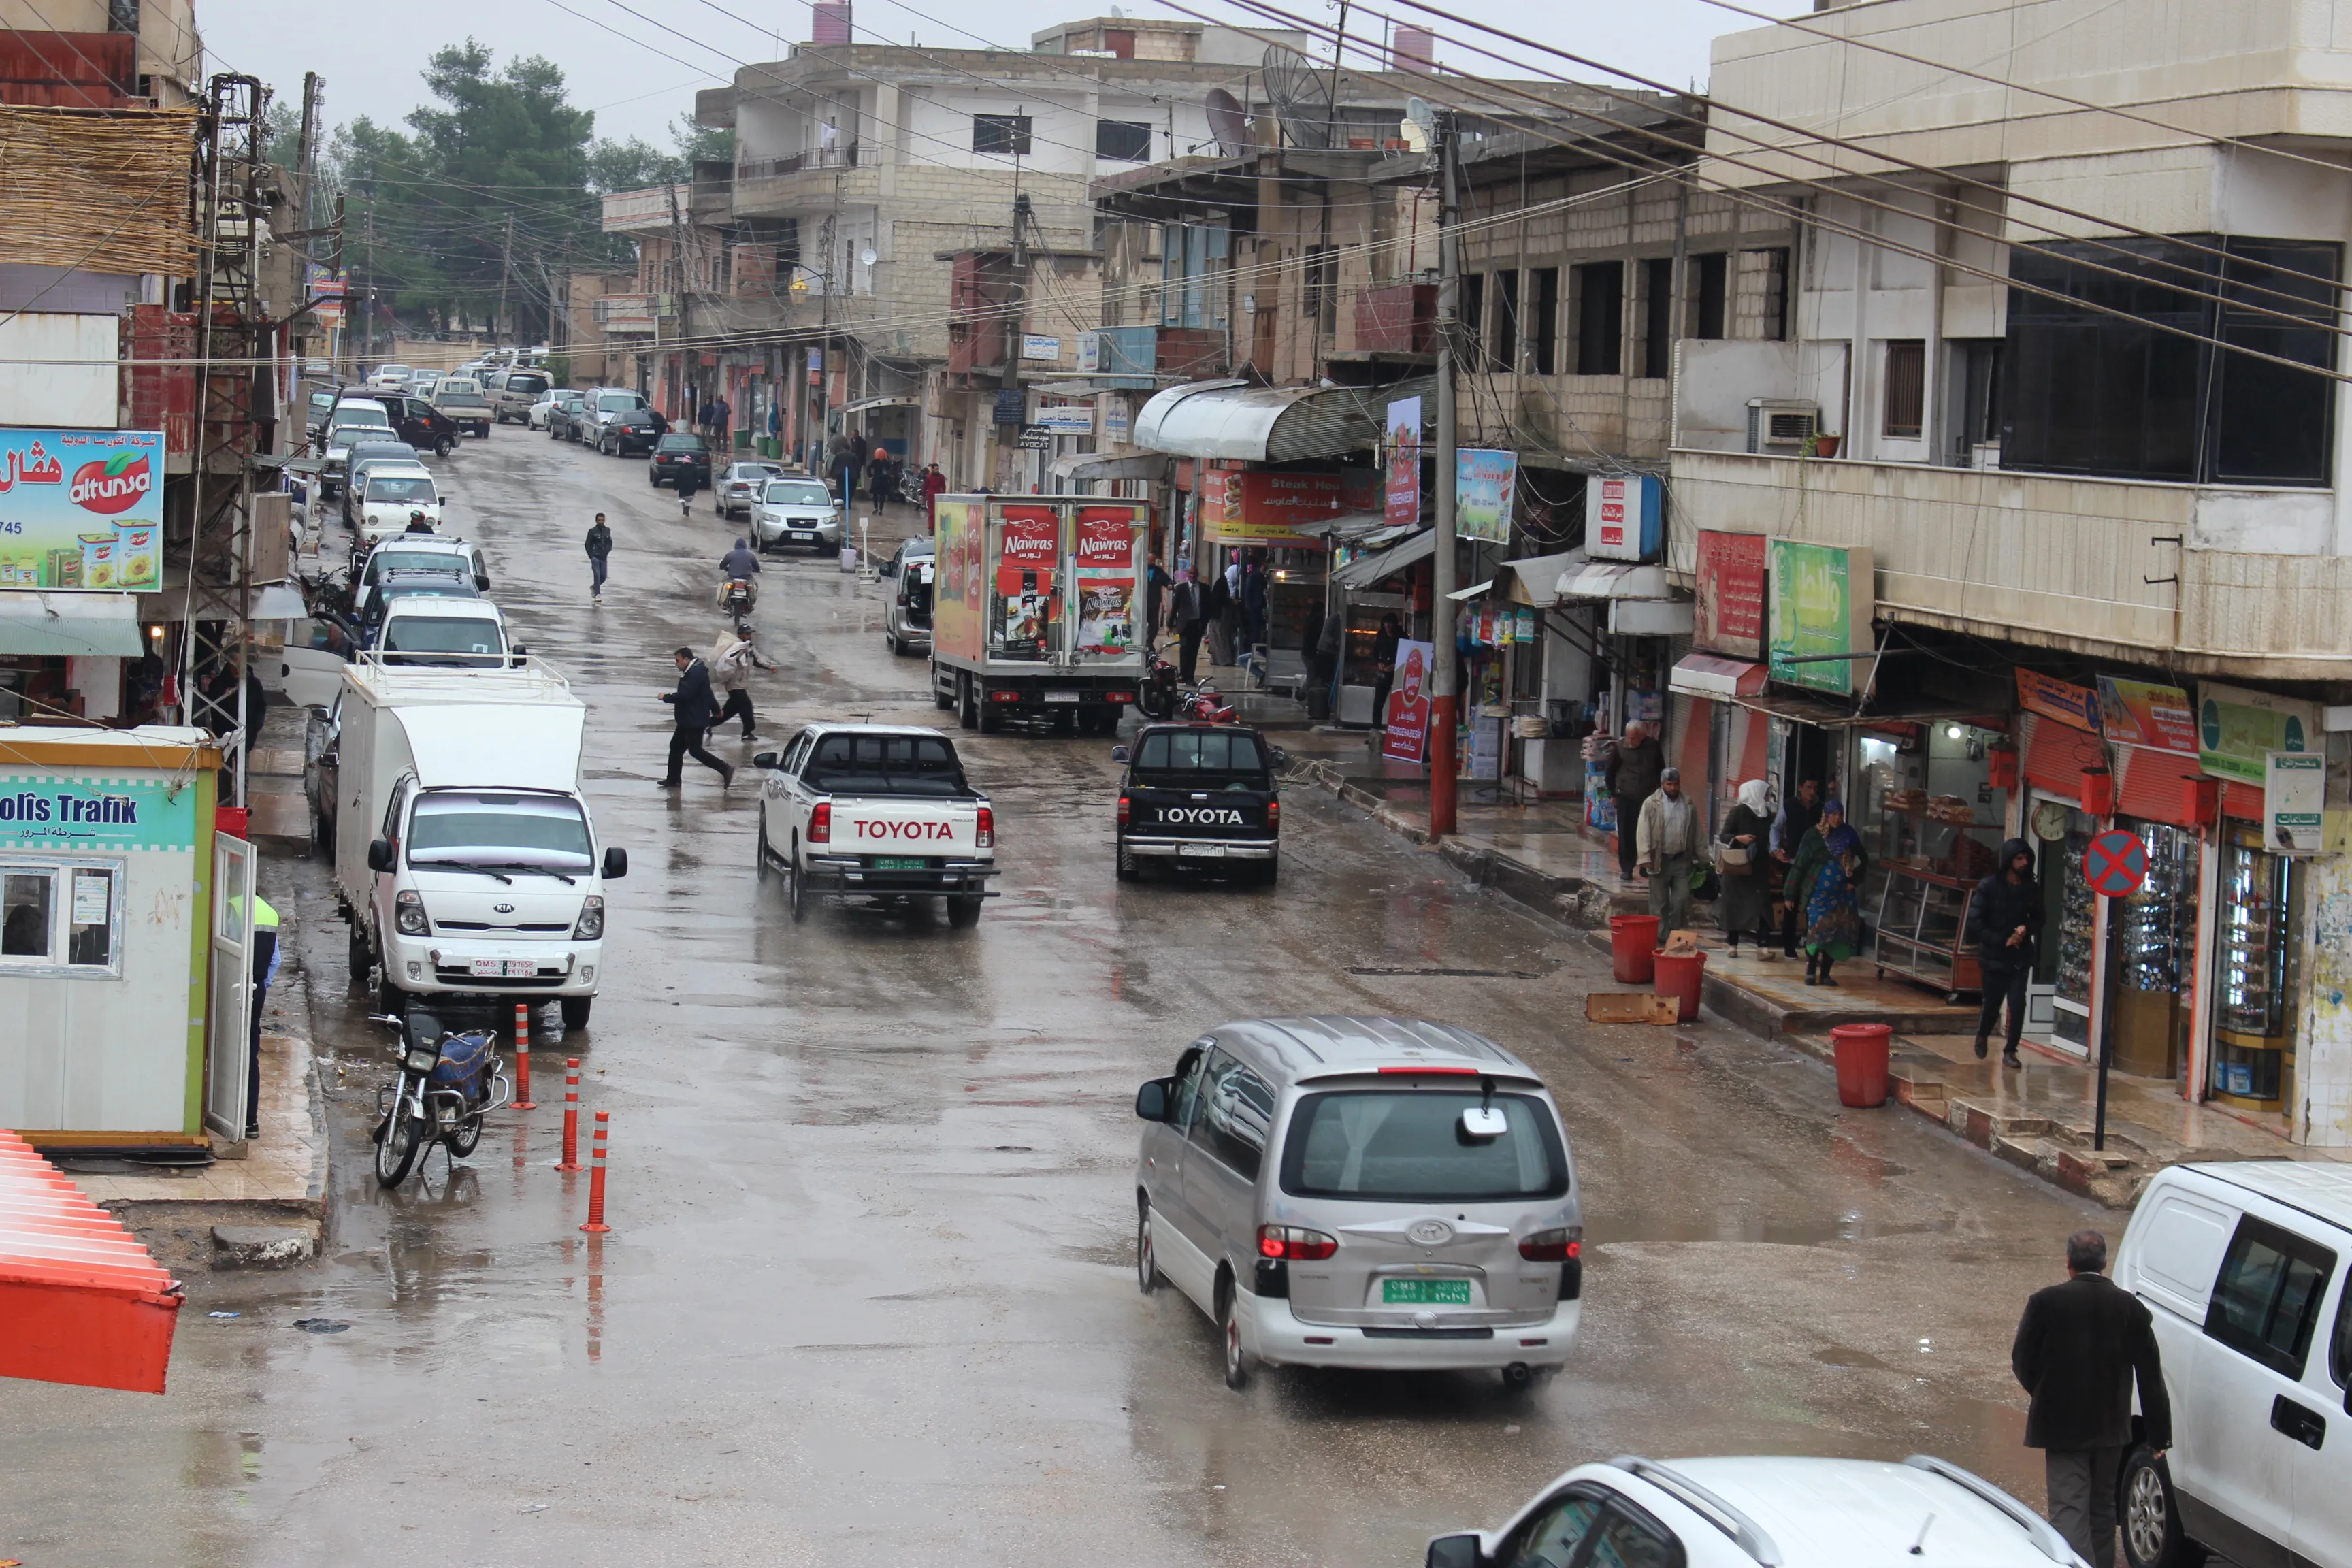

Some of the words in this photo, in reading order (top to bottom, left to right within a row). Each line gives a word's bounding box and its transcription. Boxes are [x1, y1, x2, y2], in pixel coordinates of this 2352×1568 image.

[61, 434, 91, 447] الدولية
[131, 435, 156, 448] شركة
[69, 472, 151, 504] altunsa
[1271, 478, 1309, 489] Steak
[1004, 536, 1053, 555] Nawras
[1080, 538, 1127, 556] Nawras
[1021, 589, 1039, 600] Nawras
[1085, 597, 1122, 611] Nawras
[2280, 757, 2316, 769] معرض
[1156, 808, 1244, 825] TOYOTA
[2278, 815, 2318, 824] للساعات
[19, 827, 50, 838] المرور
[52, 827, 96, 839] شرطة
[853, 820, 954, 840] TOYOTA
